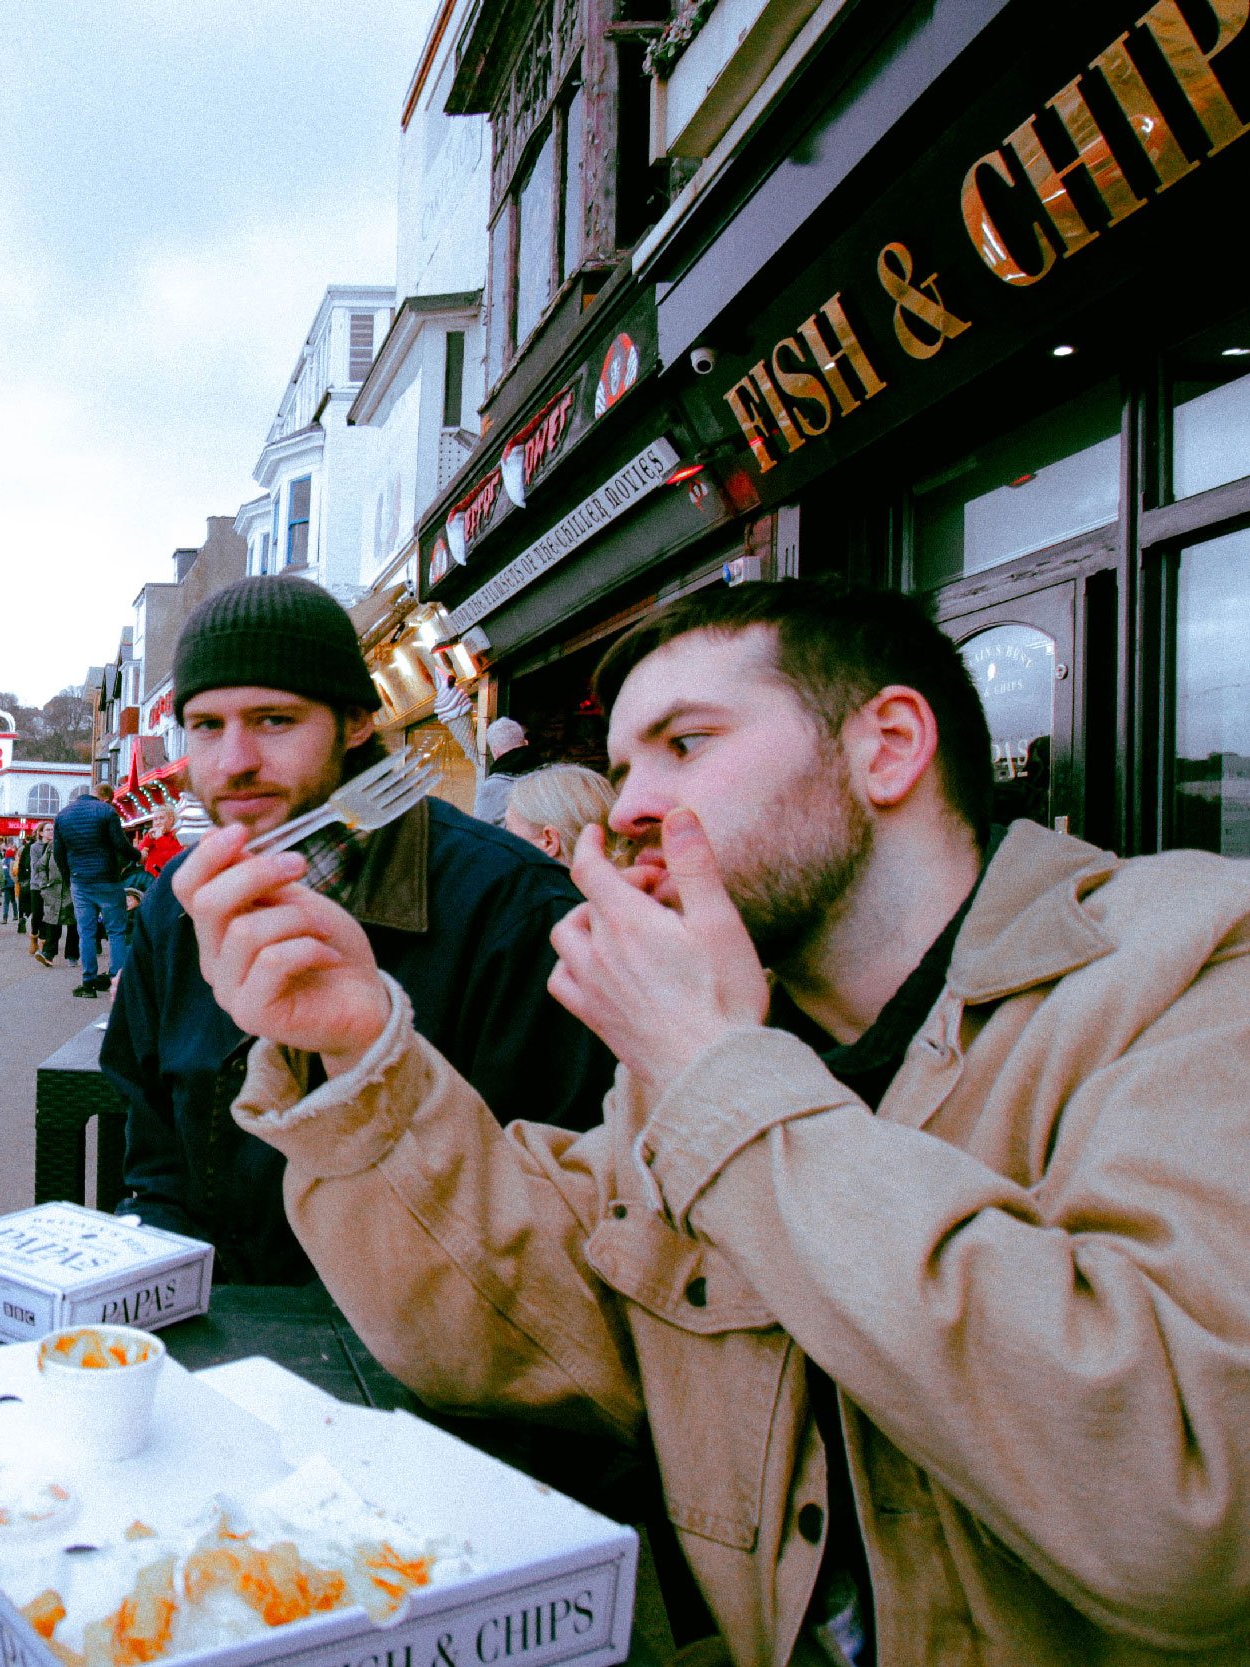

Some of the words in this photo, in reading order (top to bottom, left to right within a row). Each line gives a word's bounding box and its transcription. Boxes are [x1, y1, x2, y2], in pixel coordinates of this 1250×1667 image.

[723, 292, 887, 473] FISH
[877, 242, 972, 359] &
[961, 0, 1250, 287] CHIP
[523, 556, 539, 577] OF
[605, 449, 664, 510] MOVIES
[101, 1278, 177, 1324] PAPAS
[432, 1632, 458, 1667] &
[475, 1589, 594, 1665] CHIPS
